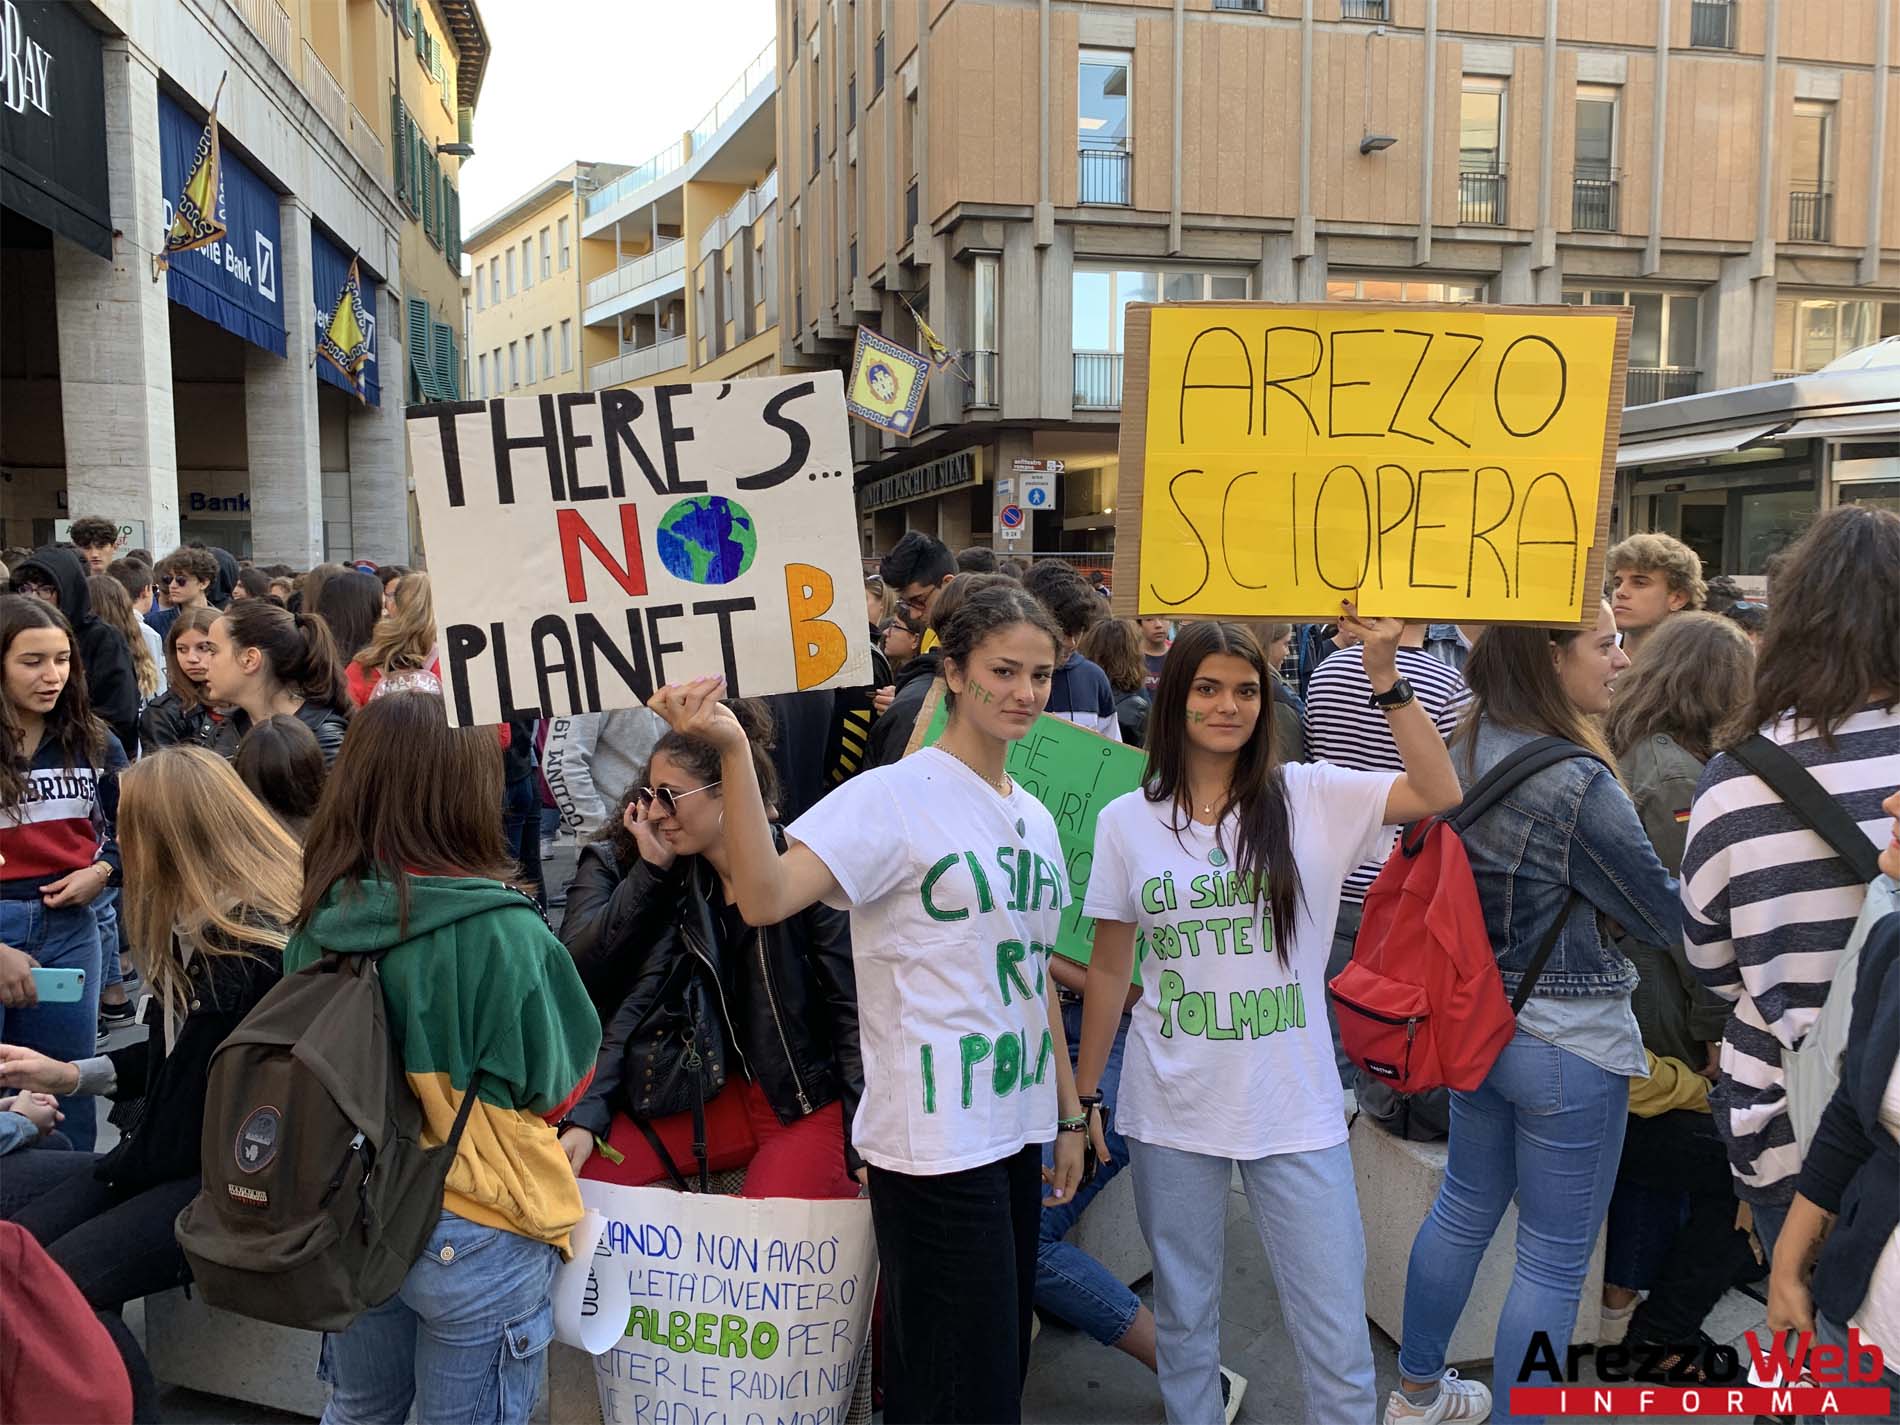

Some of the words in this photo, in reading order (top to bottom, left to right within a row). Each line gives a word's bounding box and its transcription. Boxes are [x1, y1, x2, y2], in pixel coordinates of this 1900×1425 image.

[0, 0, 54, 118] BAY
[225, 242, 252, 287] Bank
[1178, 326, 1568, 448] AREZZO
[895, 467, 925, 500] PASCHI
[939, 452, 970, 488] SIENA
[189, 491, 250, 513] Bank
[1149, 463, 1579, 607] SCIOPERA
[785, 562, 848, 691] B
[19, 775, 96, 804] BRIDGE
[920, 850, 996, 922] CI
[1150, 916, 1254, 961] ROTTE
[697, 1231, 759, 1274] NON
[624, 1304, 780, 1360] ALBERO
[788, 1318, 853, 1358] PER
[683, 1362, 720, 1398] LE
[730, 1369, 808, 1401] RADICI
